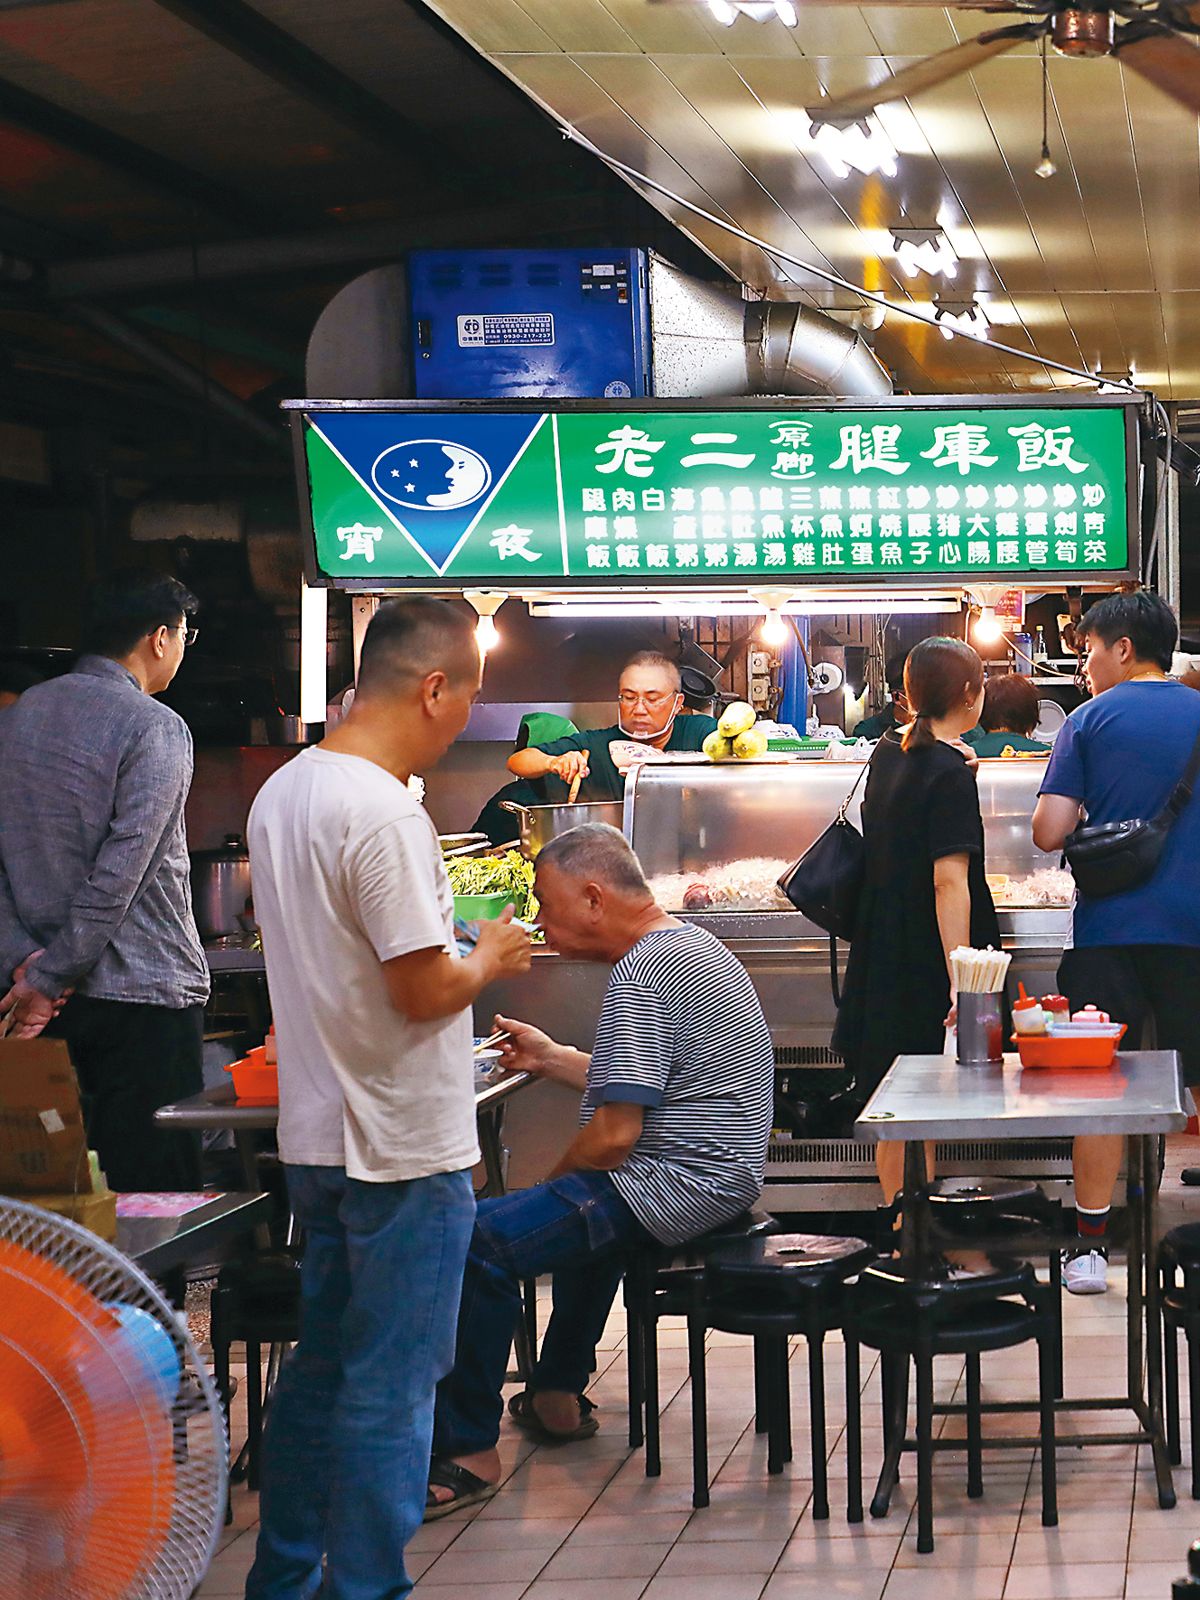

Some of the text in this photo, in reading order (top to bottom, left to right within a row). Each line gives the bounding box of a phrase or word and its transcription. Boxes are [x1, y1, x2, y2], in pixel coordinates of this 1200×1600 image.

[594, 424, 756, 478] 老二
[828, 421, 1090, 476] 腿庫飯
